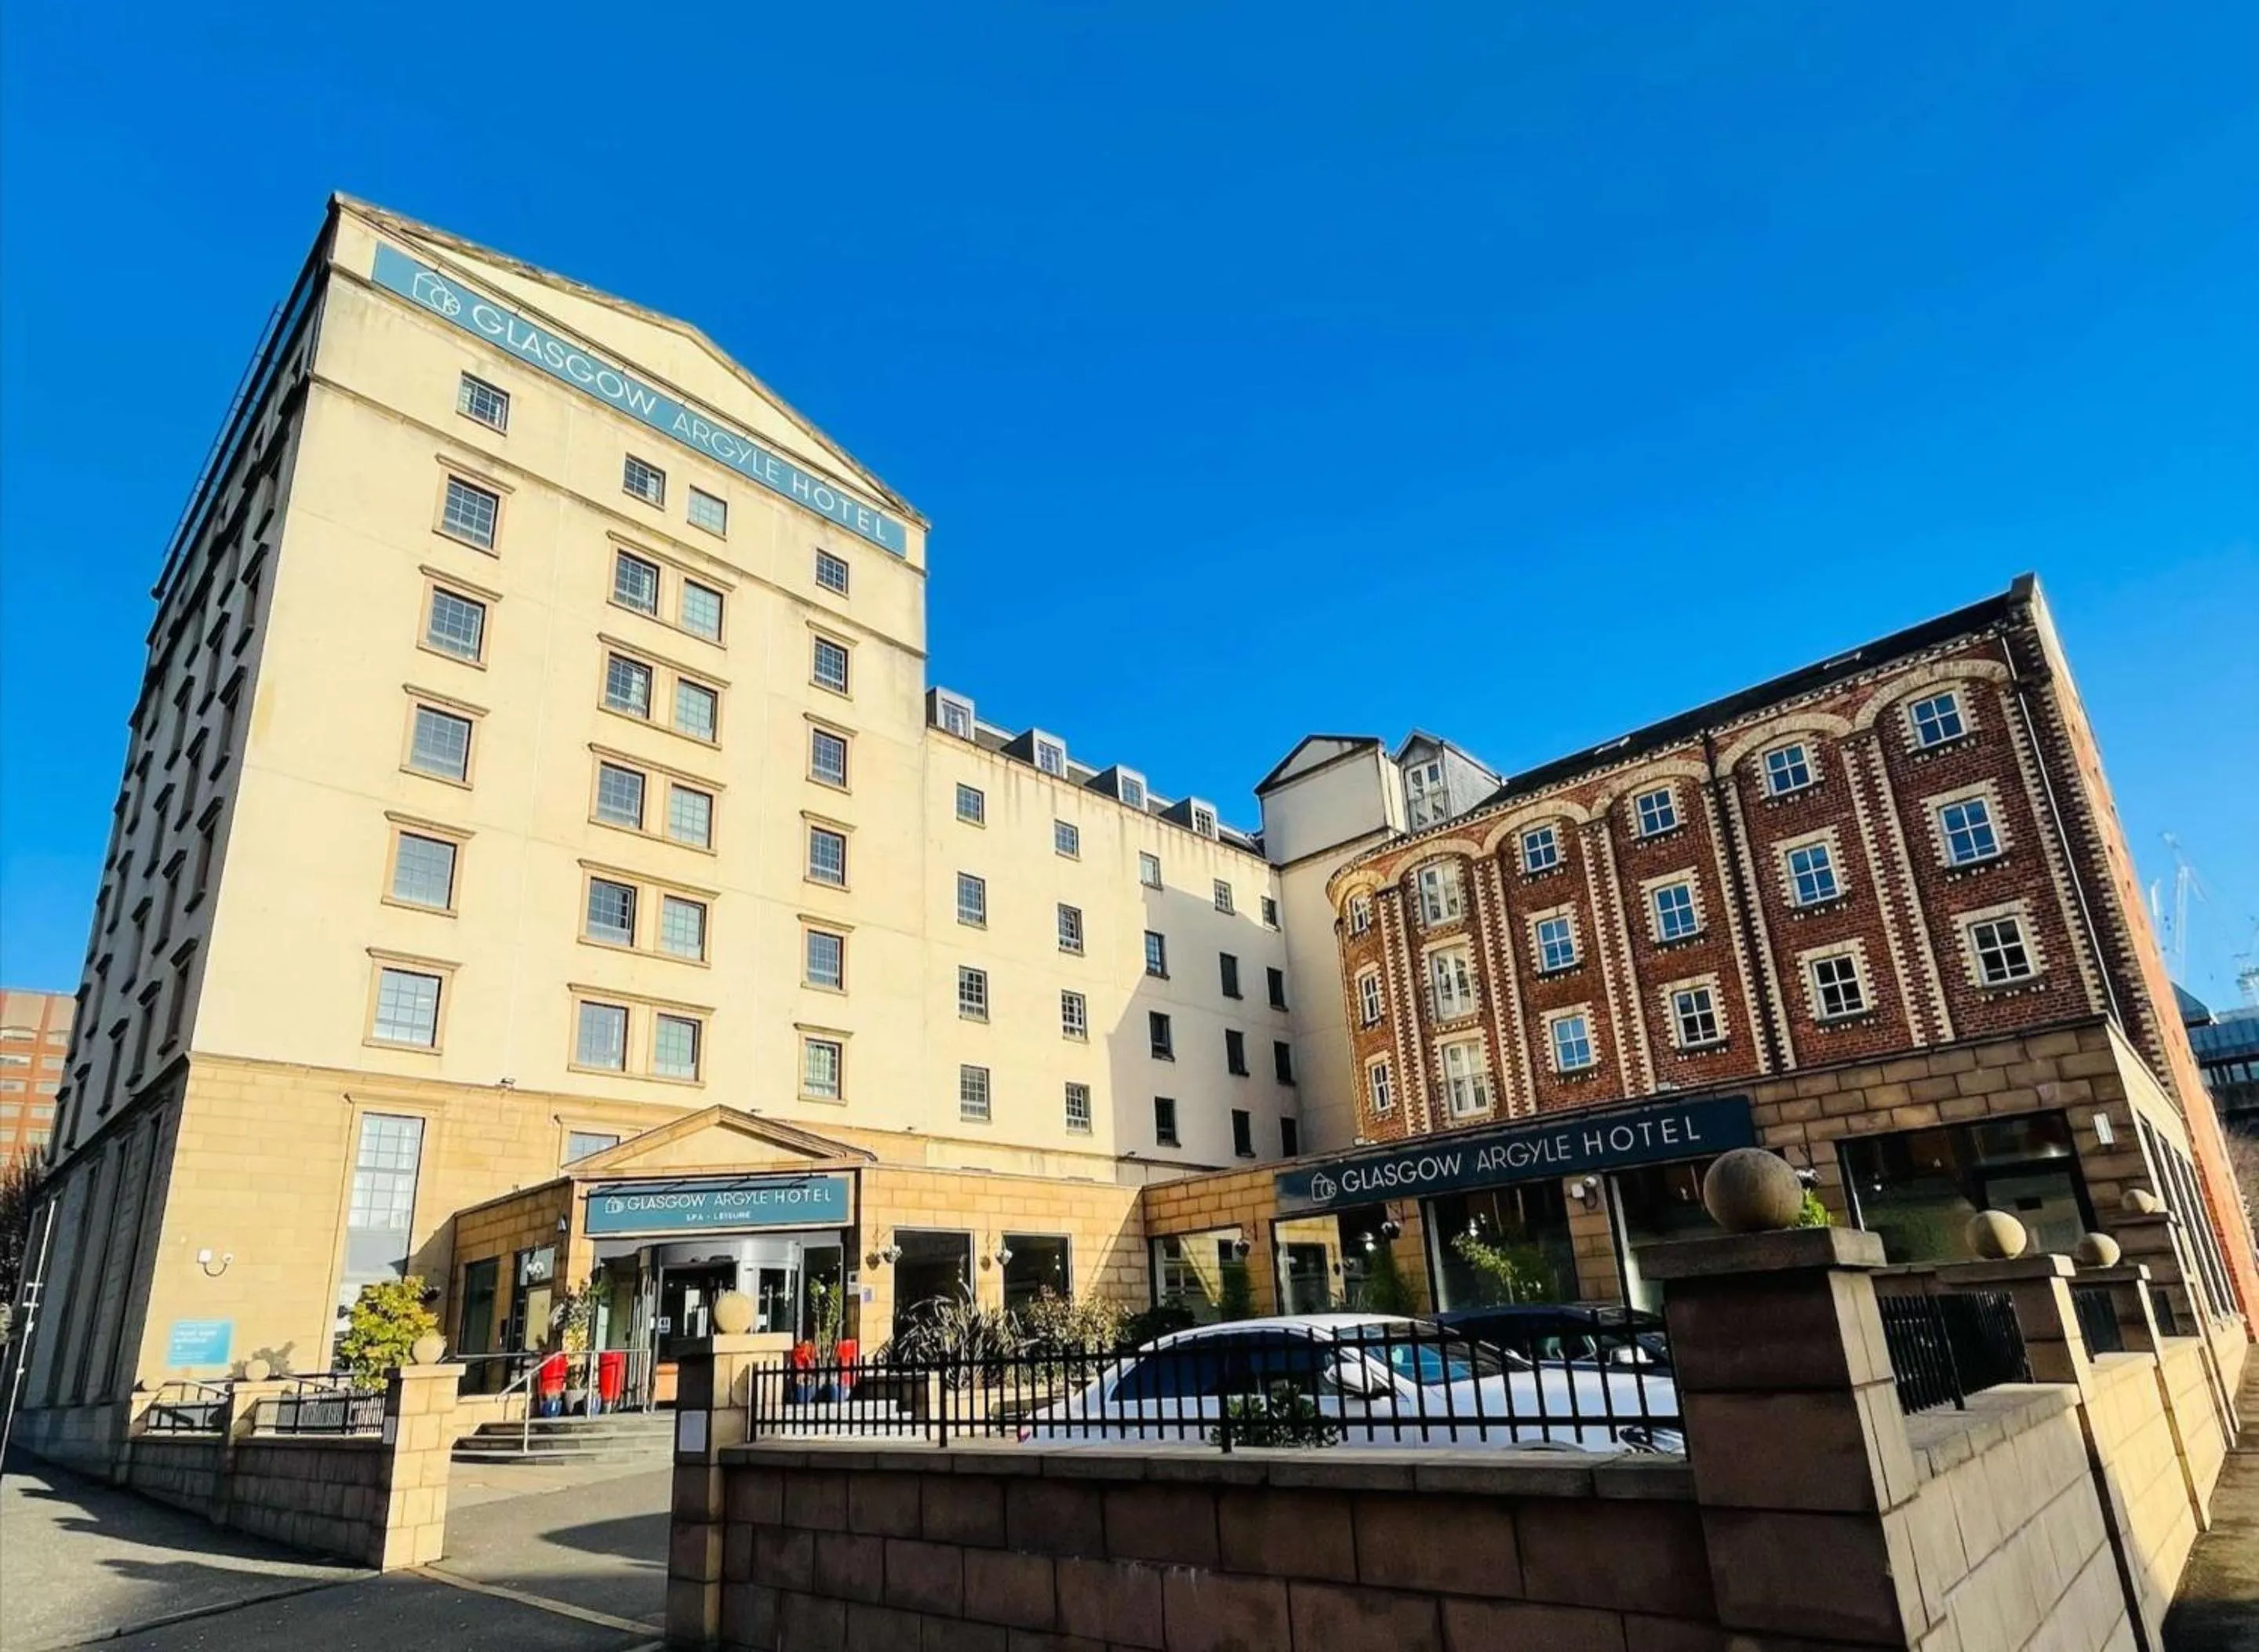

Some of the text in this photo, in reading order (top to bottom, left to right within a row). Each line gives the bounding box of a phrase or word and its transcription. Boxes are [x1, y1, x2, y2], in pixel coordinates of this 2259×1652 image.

[471, 304, 887, 542] GLASGOW ARGYLE HOTEL
[1342, 1116, 1701, 1192] GLASGOW ARGYLE HOTEL
[628, 1188, 831, 1210] GLASGOW ARGYLE HOTEL
